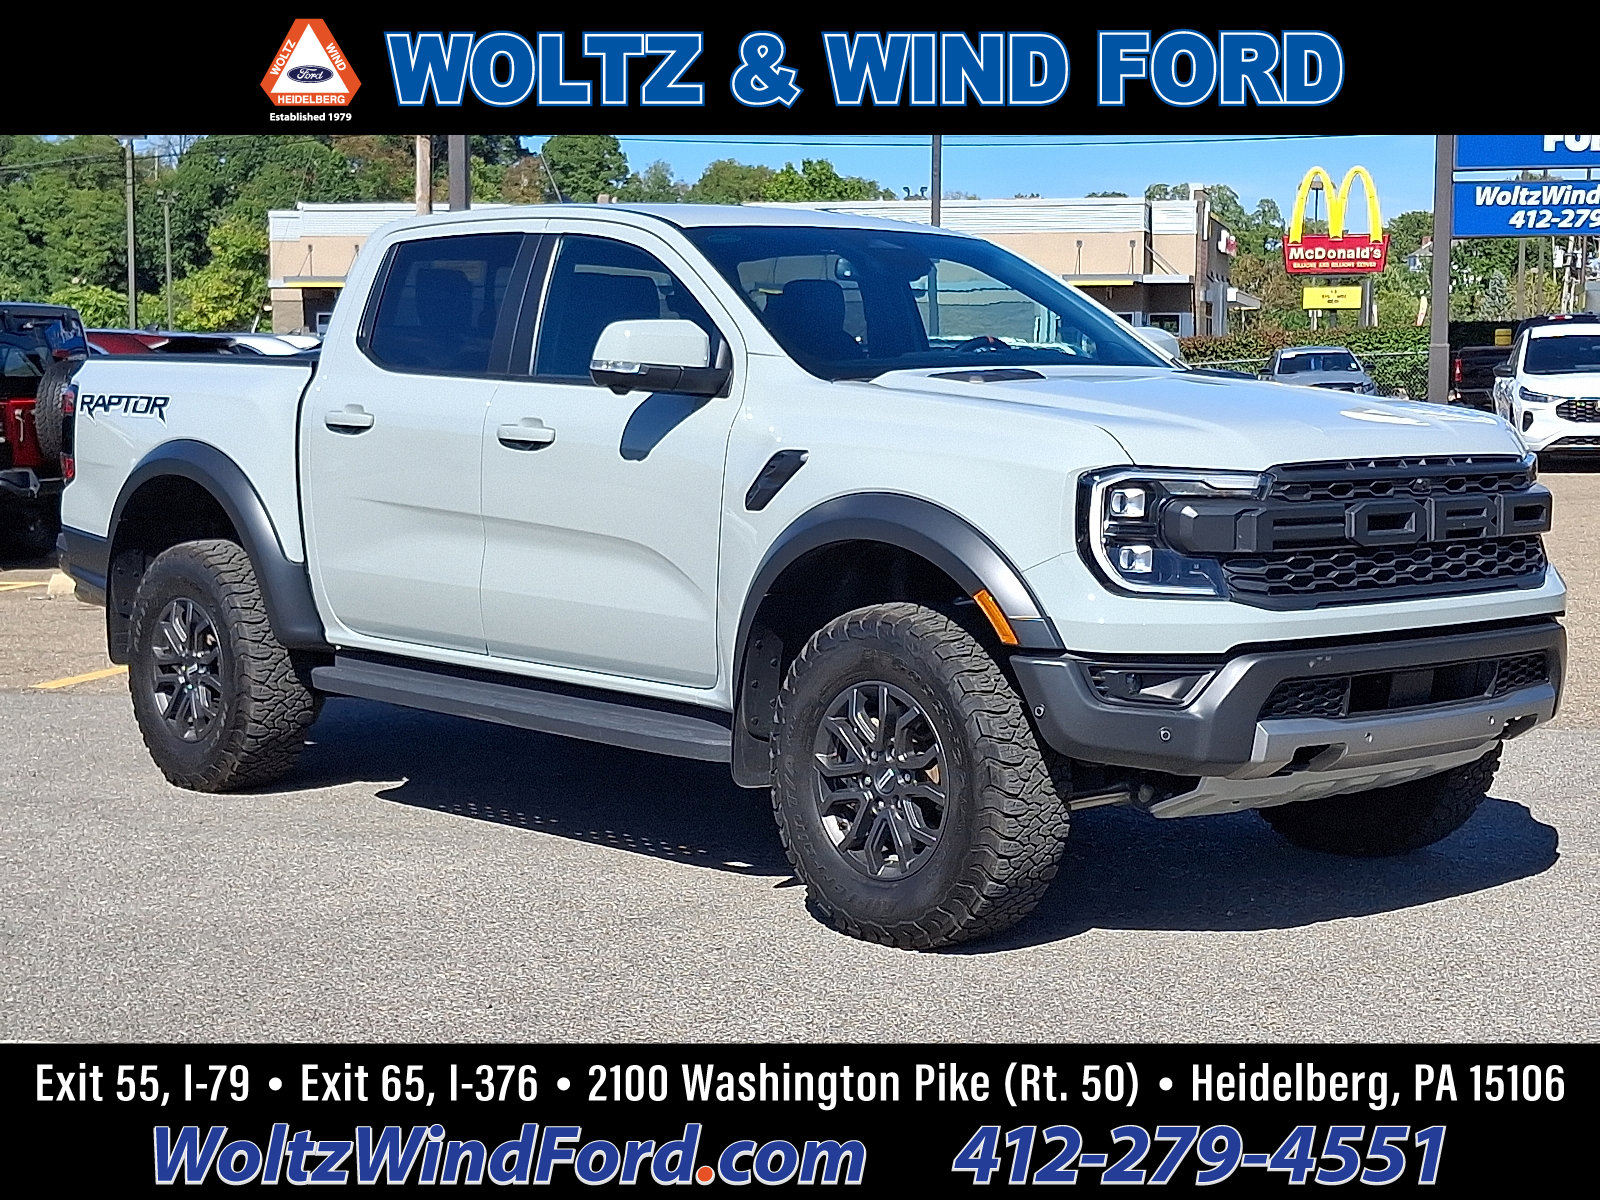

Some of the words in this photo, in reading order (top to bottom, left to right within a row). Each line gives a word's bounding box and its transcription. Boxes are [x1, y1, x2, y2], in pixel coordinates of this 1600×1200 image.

[1288, 247, 1382, 260] McDonald's
[79, 394, 171, 427] RAPTOR
[1236, 492, 1552, 552] FORD
